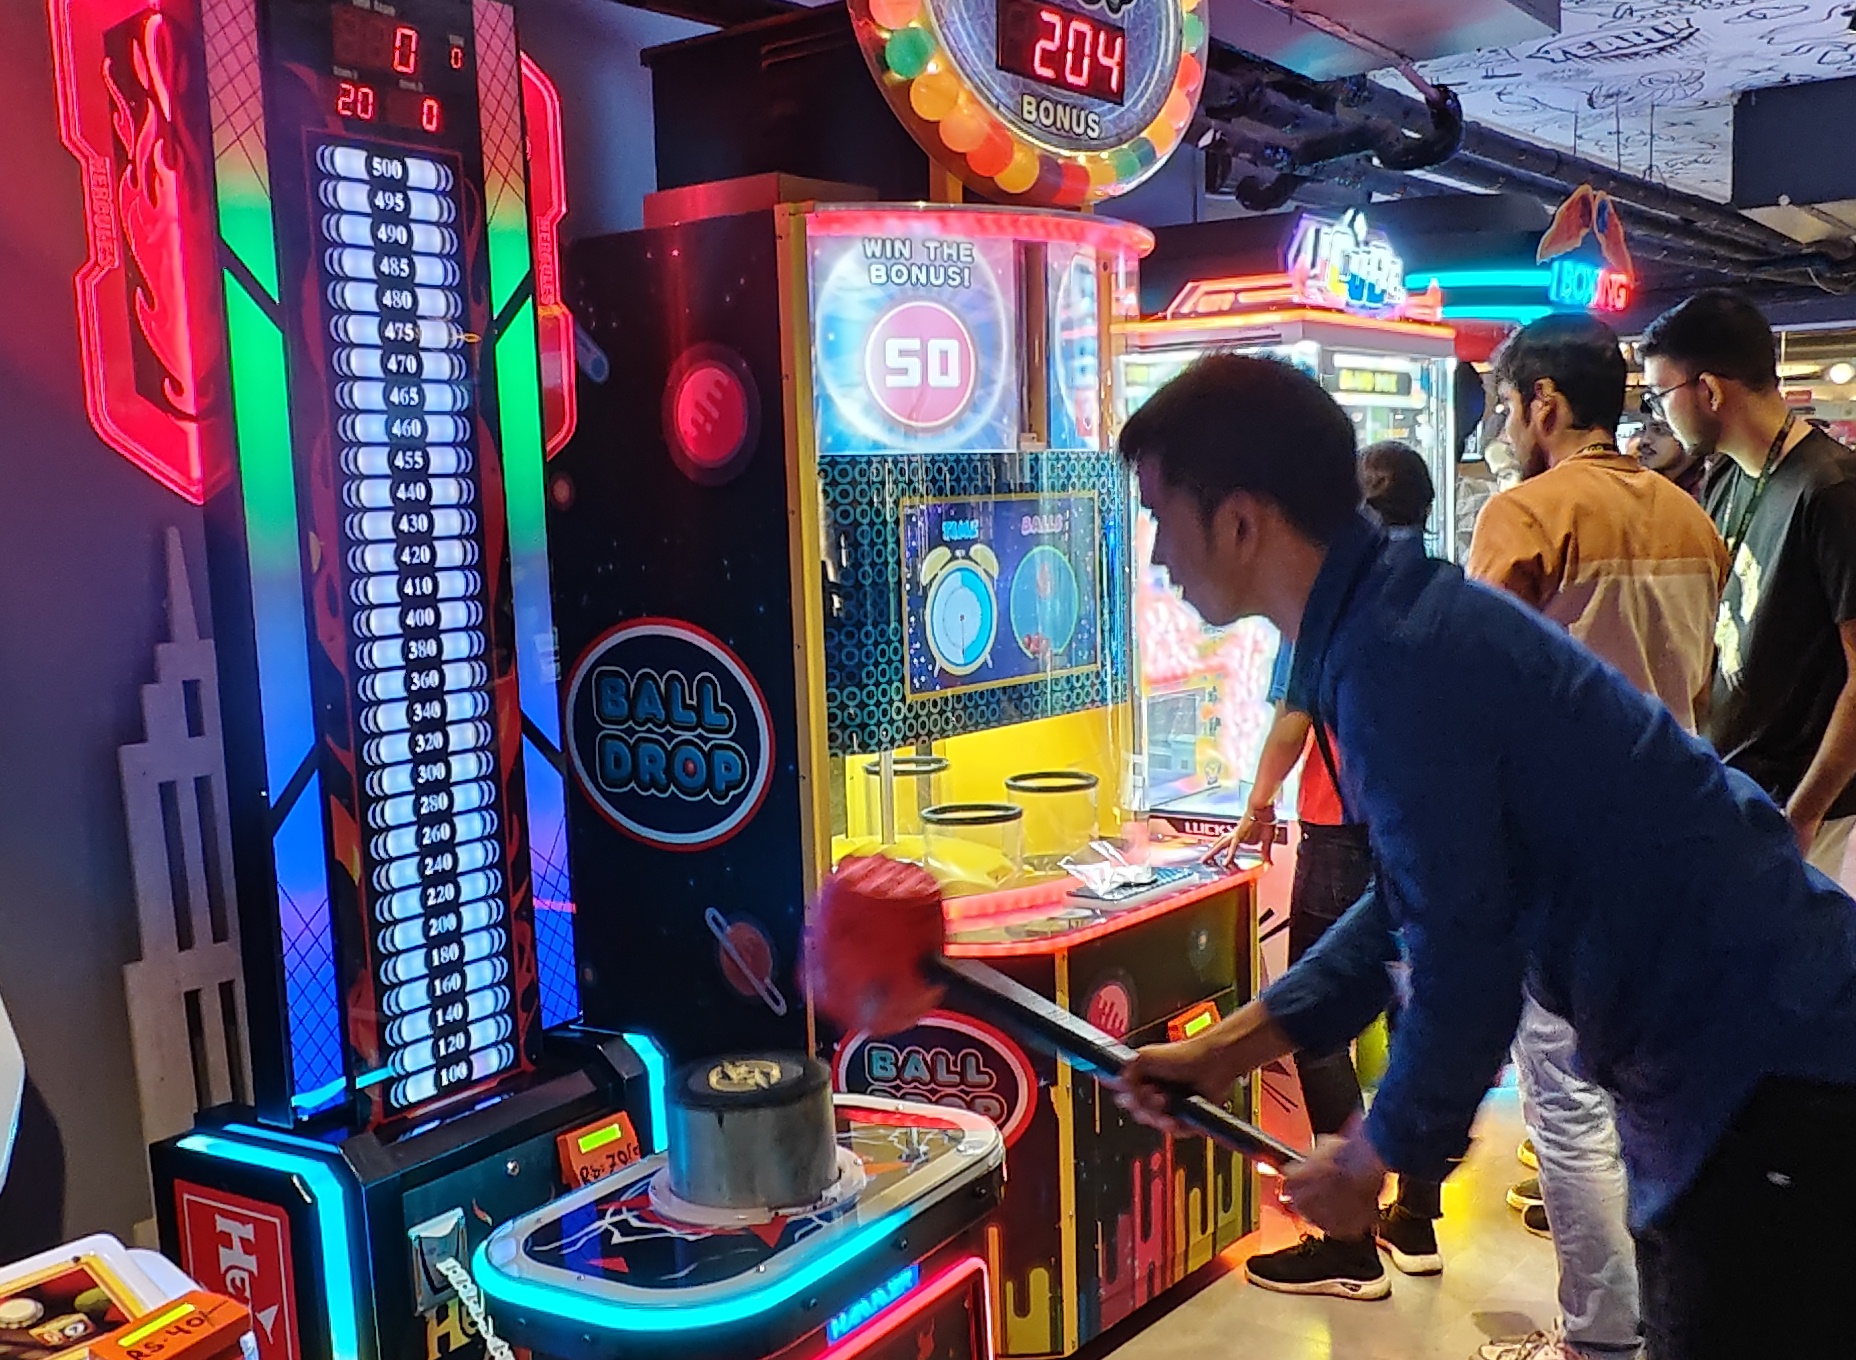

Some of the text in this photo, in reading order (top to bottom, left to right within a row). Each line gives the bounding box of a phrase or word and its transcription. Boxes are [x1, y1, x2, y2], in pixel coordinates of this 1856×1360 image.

[393, 26, 418, 74] 0
[1033, 9, 1123, 94] 204
[337, 82, 439, 133] 20 0
[1021, 93, 1100, 139] BONUS
[372, 156, 402, 180] 500
[374, 190, 405, 212] 495
[378, 223, 408, 245] 490
[863, 238, 974, 263] WIN THE
[380, 256, 410, 277] 485
[869, 263, 972, 288] BONUS!
[382, 289, 412, 310] 480
[385, 321, 415, 341] 475
[387, 353, 417, 374] 470
[885, 338, 961, 388] 50
[389, 386, 419, 406] 465
[391, 418, 422, 438] 460
[394, 450, 424, 469] 455
[396, 481, 426, 501] 440
[399, 513, 429, 533] 430
[401, 544, 431, 565] 420
[403, 576, 433, 596] 410
[405, 607, 435, 628] 400
[408, 638, 438, 660] 380
[410, 669, 440, 691] 360
[412, 700, 442, 722] 340
[595, 669, 734, 735] BALL
[414, 731, 444, 753] 320
[417, 762, 446, 784] 300
[599, 733, 746, 802] DROP
[420, 792, 449, 814] 280
[422, 822, 451, 845] 260
[424, 852, 453, 875] 240
[426, 882, 455, 906] 220
[428, 912, 457, 937] 200
[432, 942, 460, 967] 180
[433, 972, 462, 997] 160
[435, 1001, 464, 1027] 140
[438, 1031, 466, 1057] 120
[440, 1060, 469, 1087] 100
[867, 1044, 994, 1090] BALL
